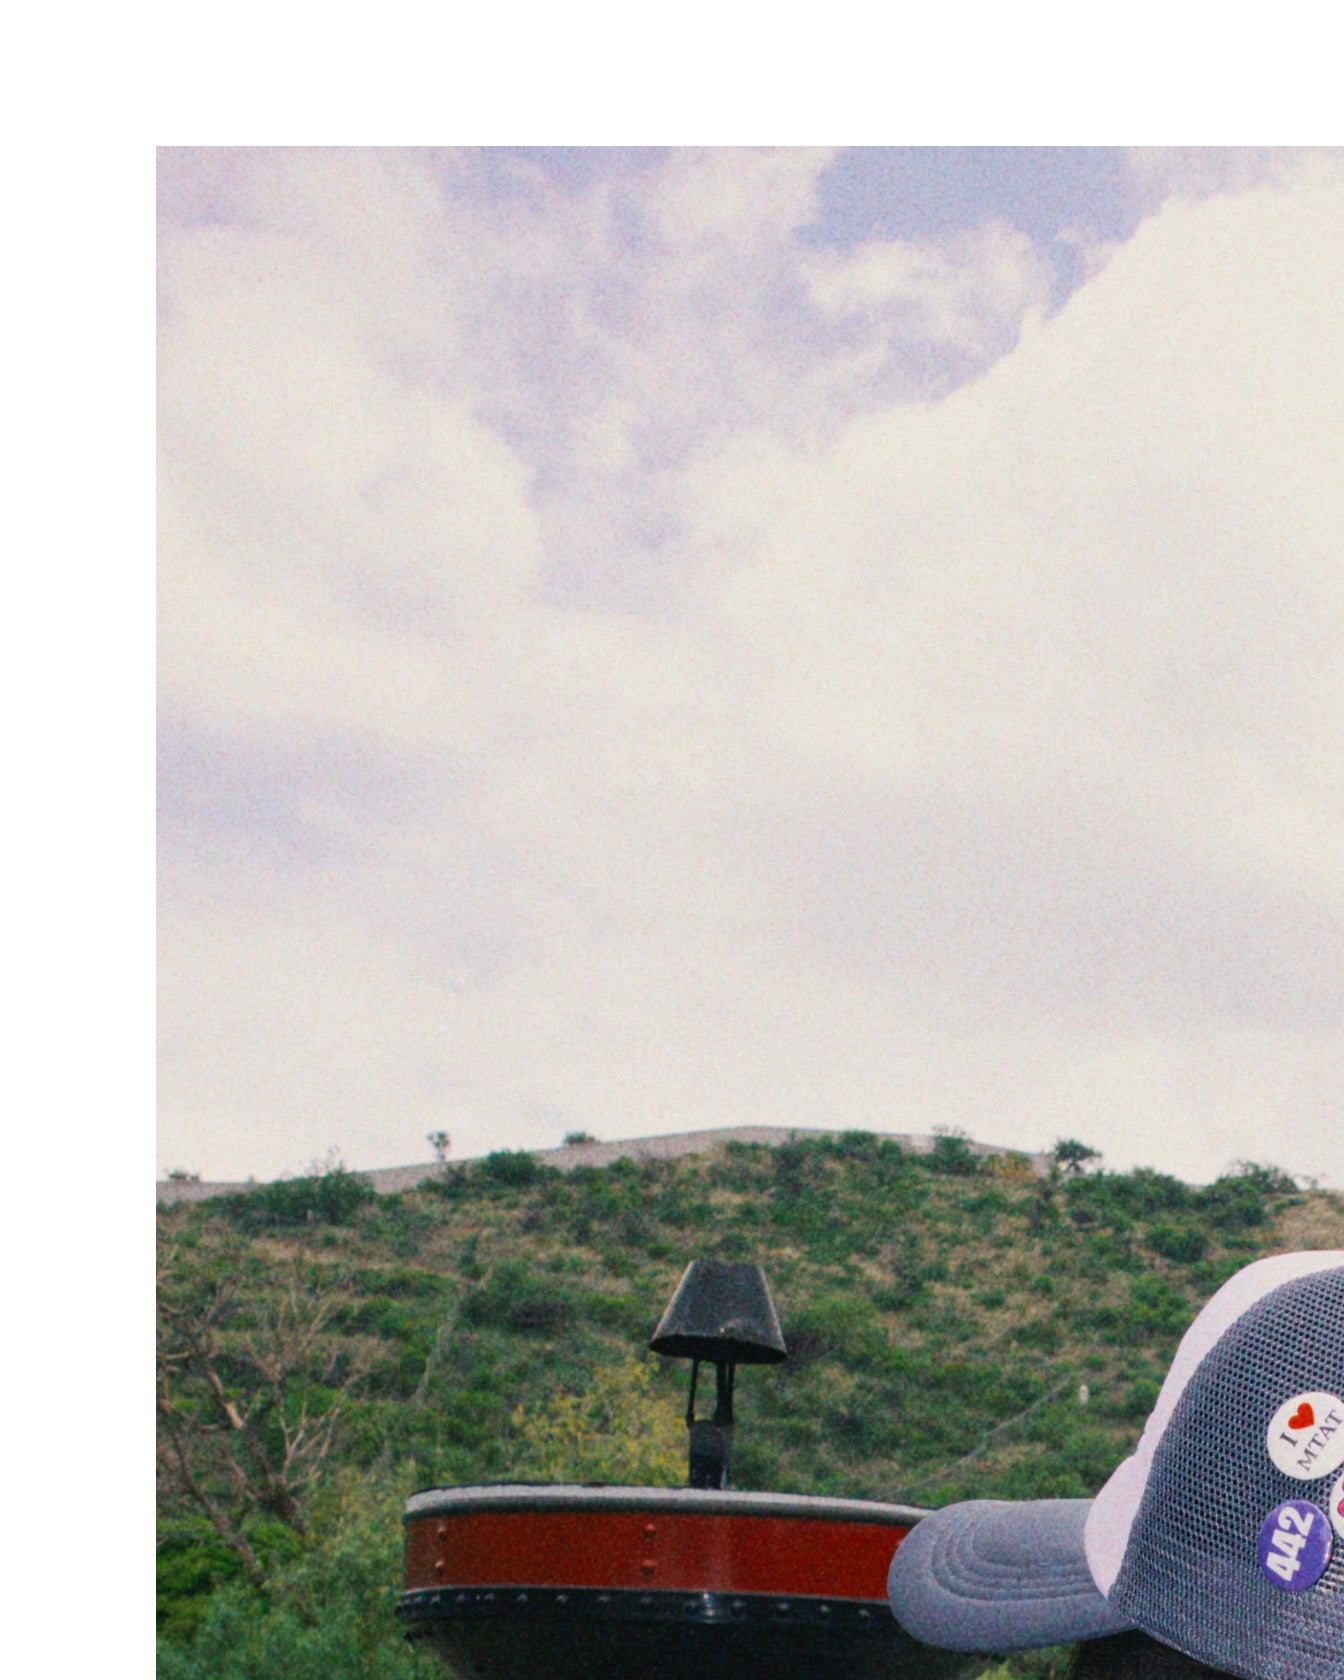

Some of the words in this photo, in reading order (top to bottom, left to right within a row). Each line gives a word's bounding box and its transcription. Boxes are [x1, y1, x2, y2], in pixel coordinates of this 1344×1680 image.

[1280, 1431, 1298, 1448] I
[1297, 1409, 1343, 1472] MTAT
[1266, 1506, 1314, 1582] 442
